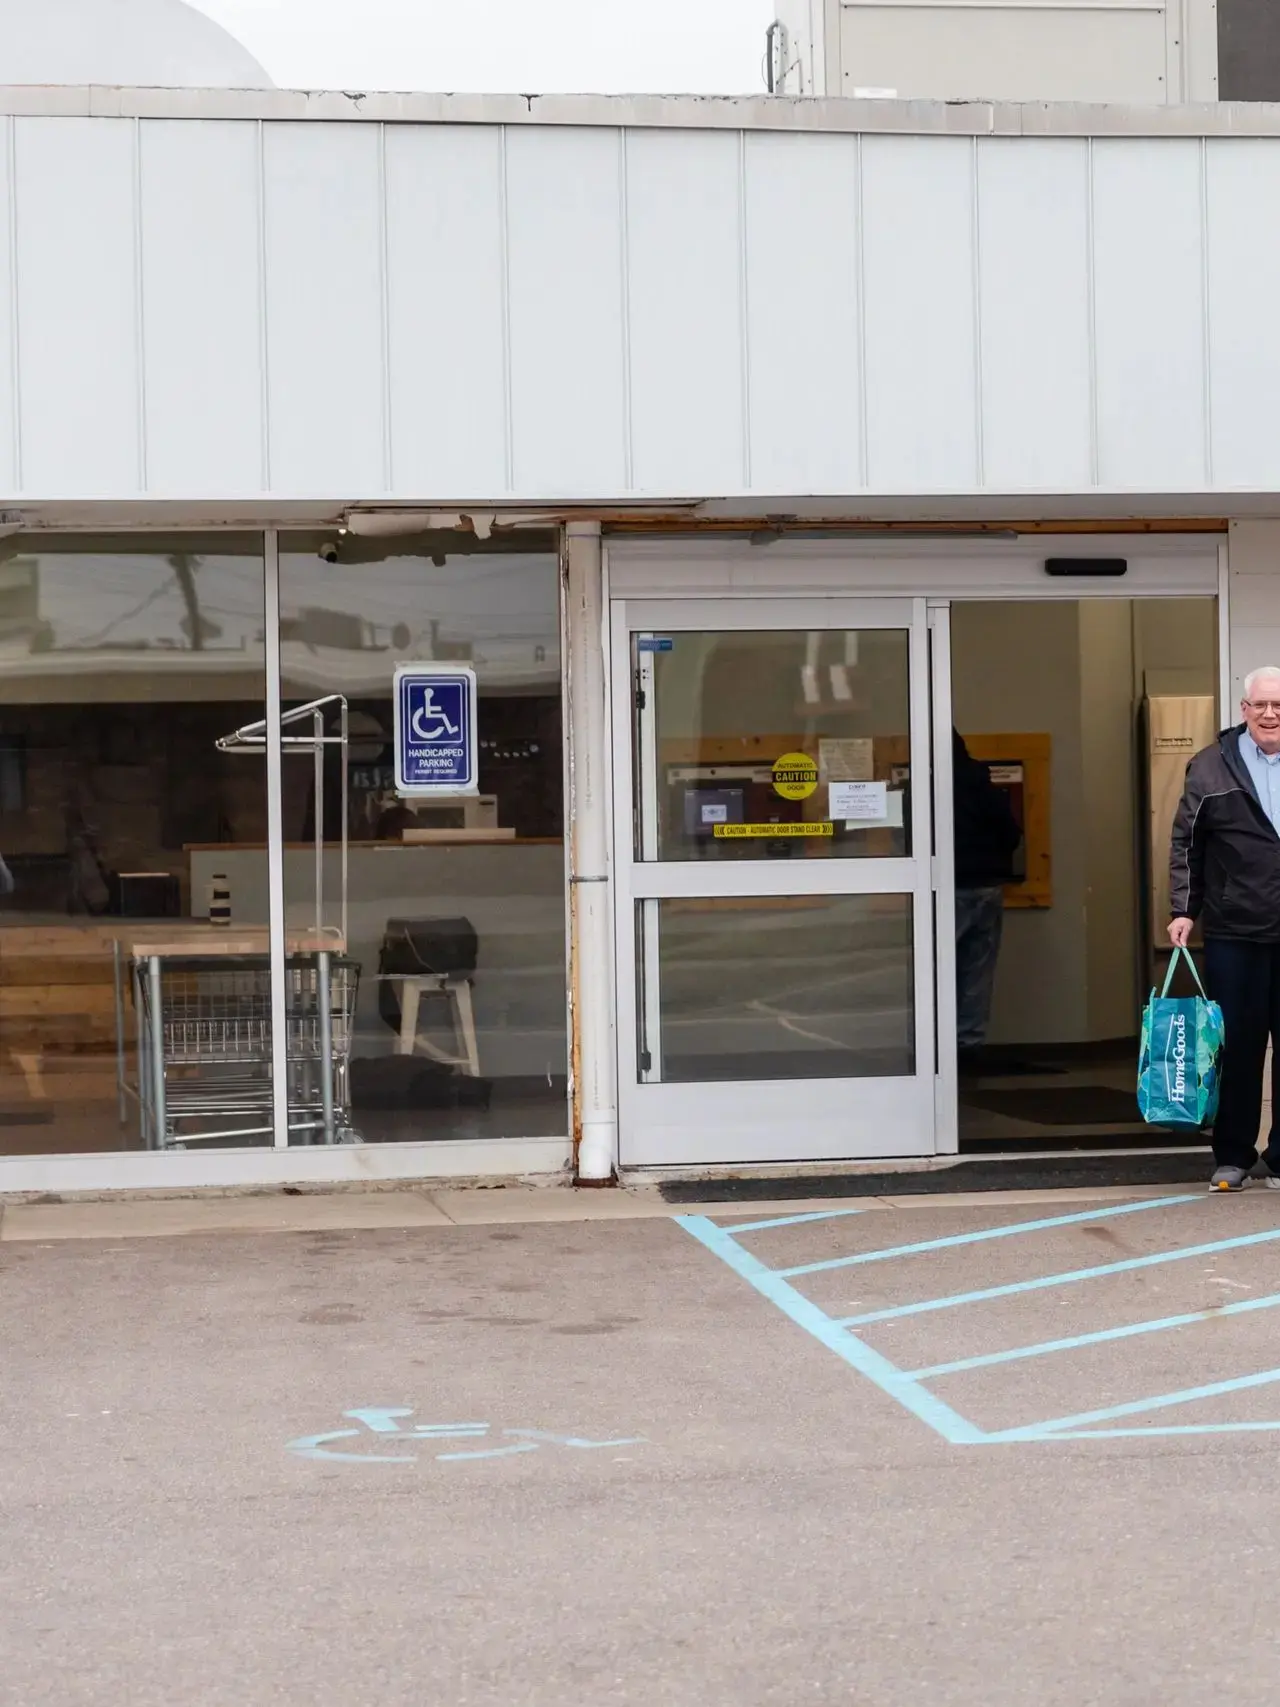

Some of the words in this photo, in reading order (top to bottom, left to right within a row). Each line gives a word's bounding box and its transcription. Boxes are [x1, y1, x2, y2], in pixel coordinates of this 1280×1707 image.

[408, 748, 464, 757] HANDICAPPED
[419, 759, 454, 768] PARKING
[775, 771, 816, 781] CAUTION
[727, 825, 746, 834] CAUTION
[750, 825, 776, 834] AUTOMATIC
[777, 825, 790, 833] DOOR
[790, 825, 805, 833] STAND
[805, 824, 821, 833] CLEAR
[1171, 1014, 1186, 1103] HomeGoods
